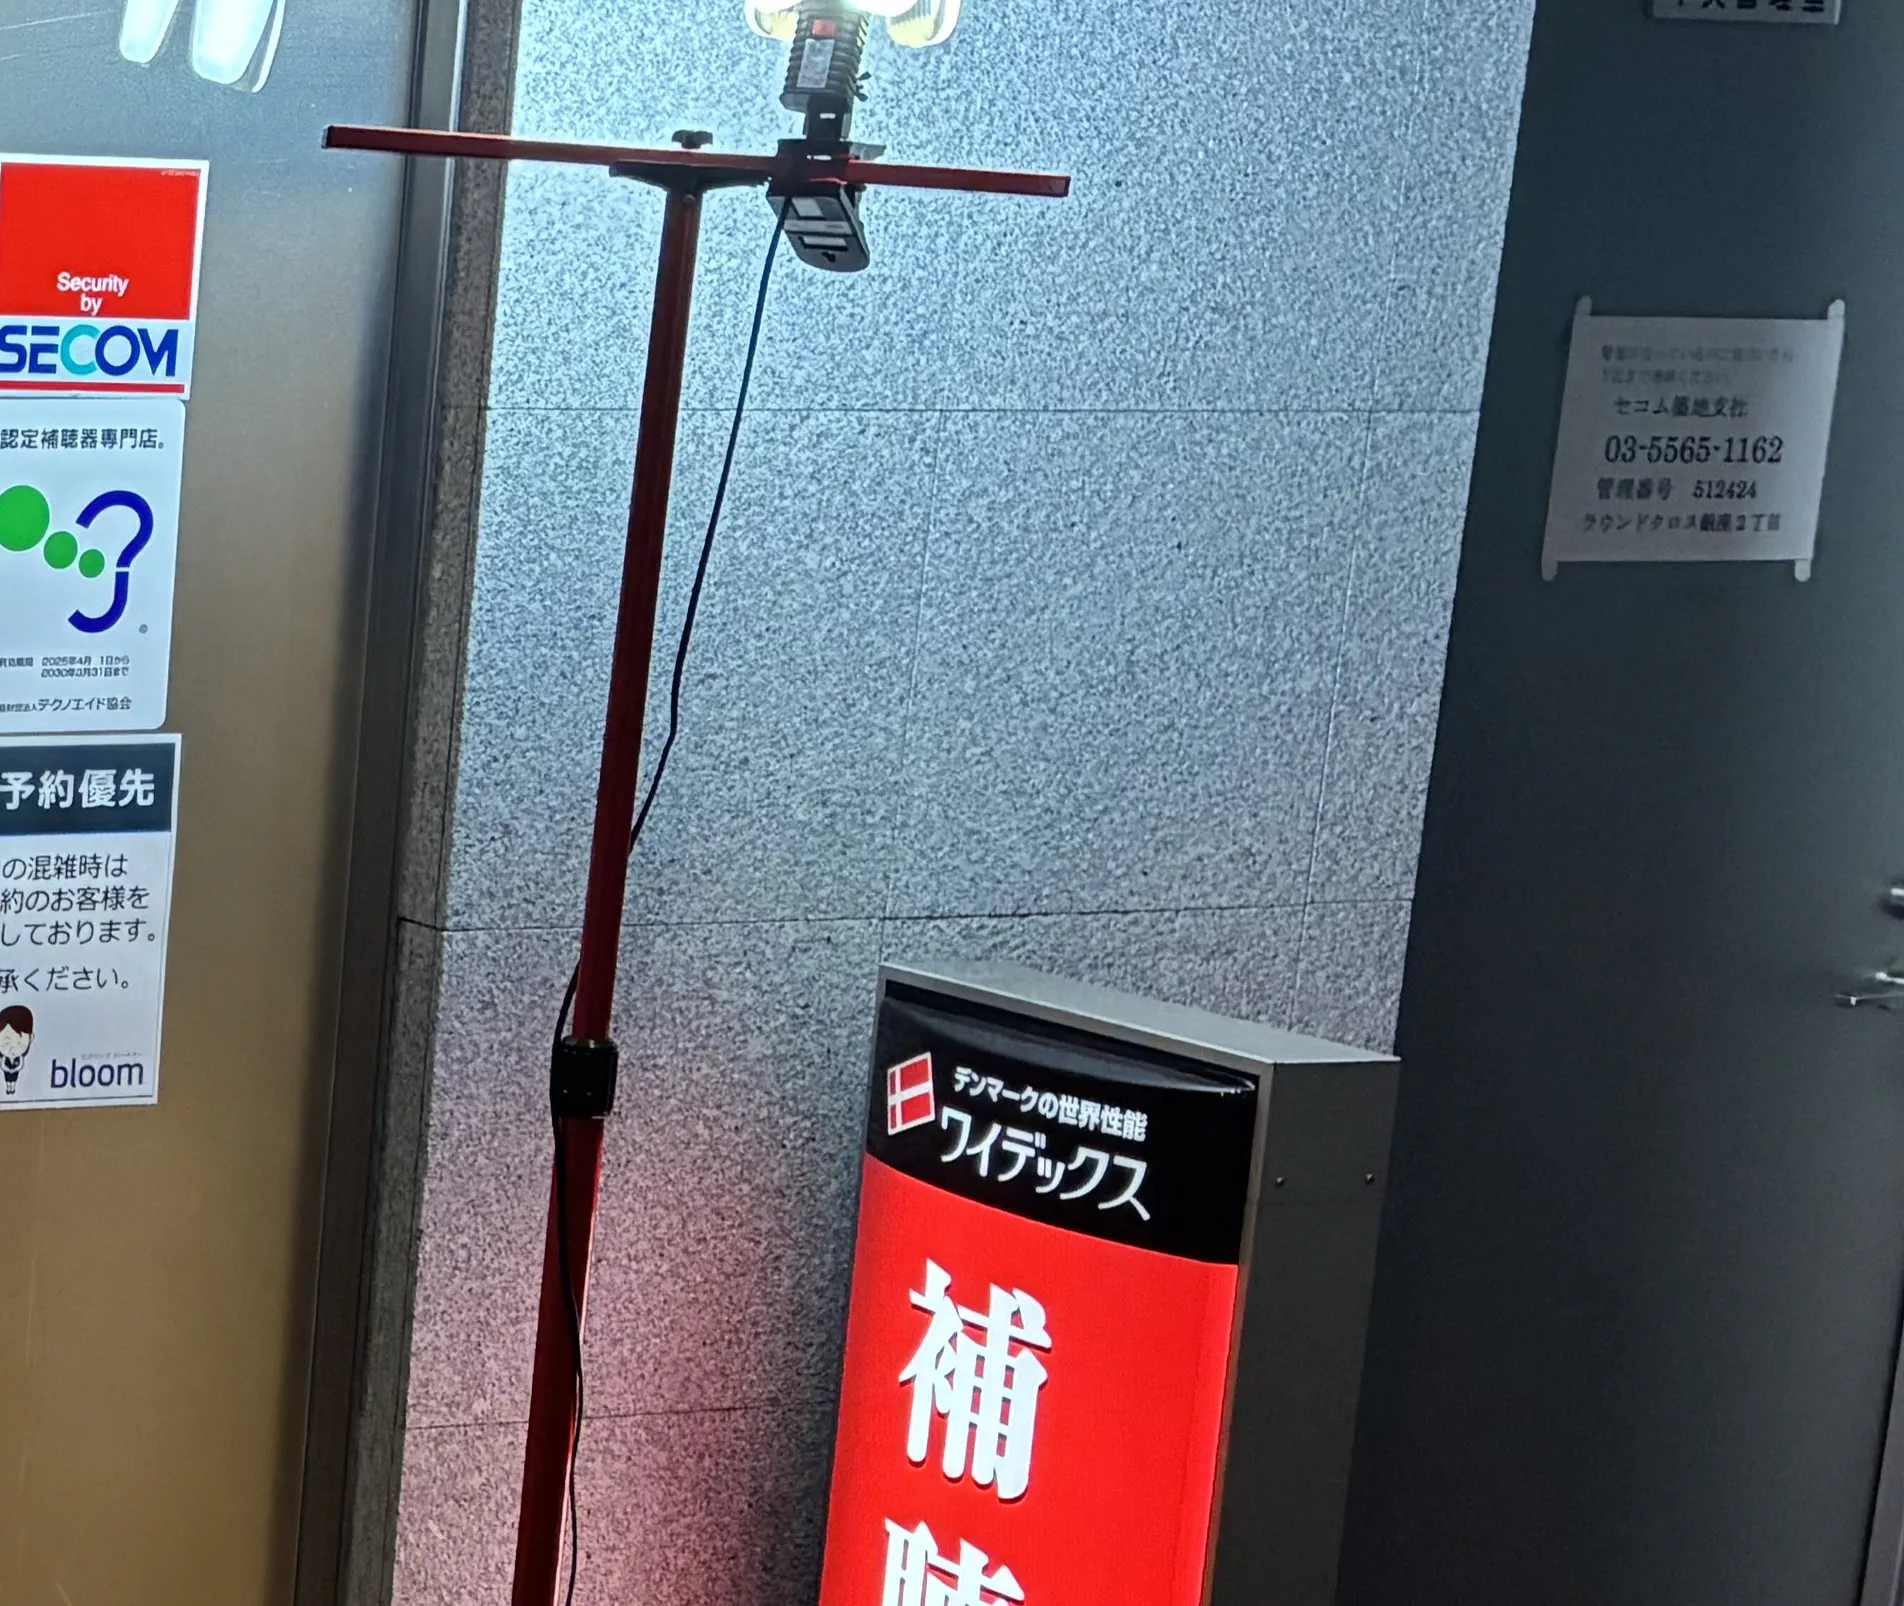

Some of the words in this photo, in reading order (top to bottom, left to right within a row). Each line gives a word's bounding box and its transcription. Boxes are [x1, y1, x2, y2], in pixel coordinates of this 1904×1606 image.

[56, 271, 130, 297] Security
[80, 295, 103, 316] by
[1604, 434, 1784, 463] 03-5565-1162
[50, 1059, 144, 1089] bloom
[953, 1065, 1149, 1143] デンマークの世界性能
[940, 1105, 1152, 1222] ワイデックス
